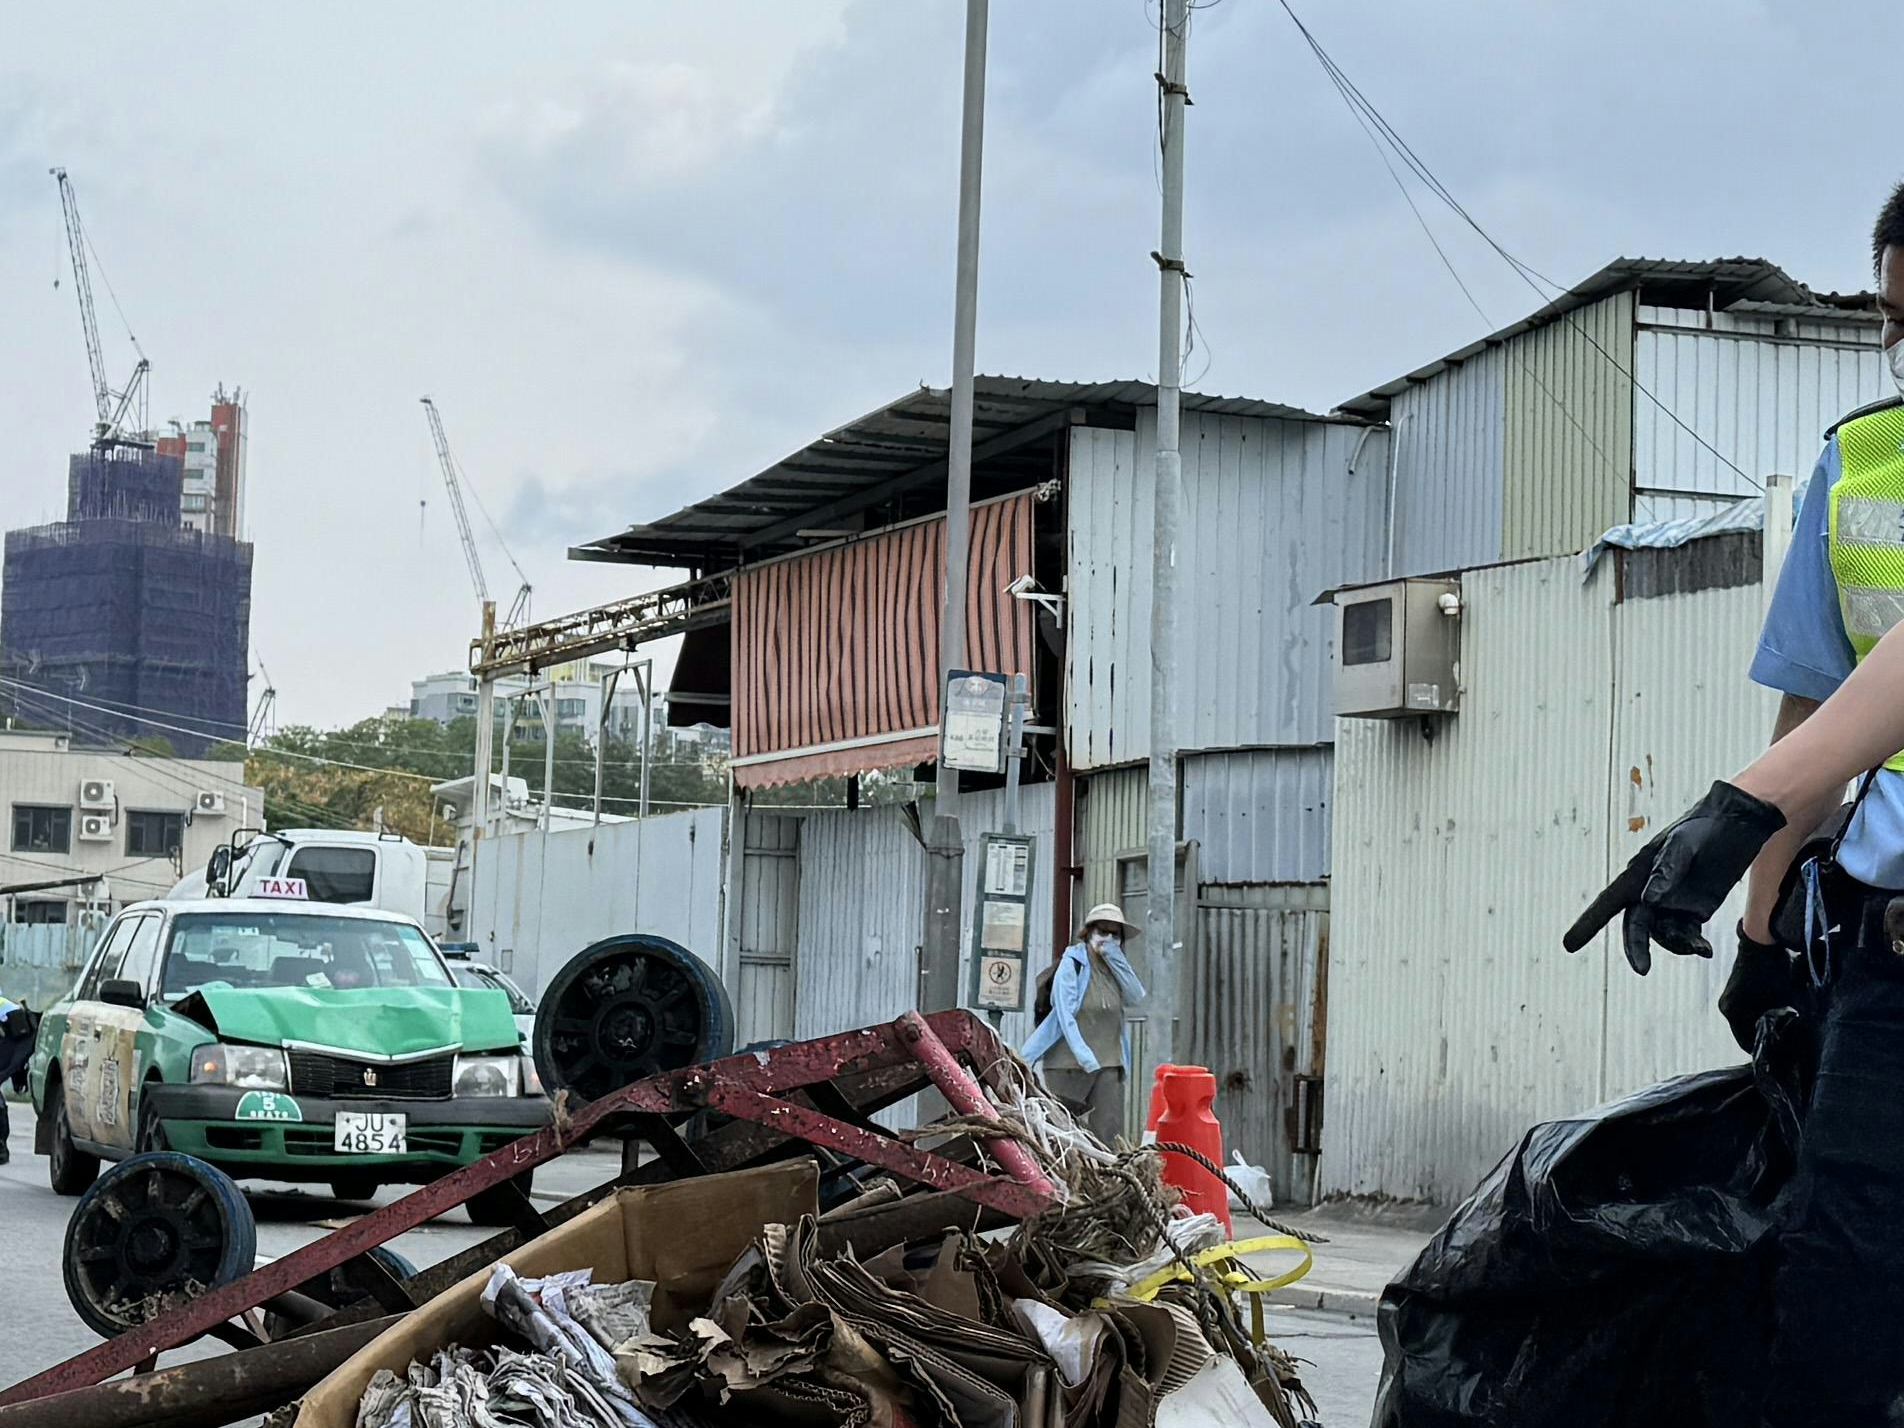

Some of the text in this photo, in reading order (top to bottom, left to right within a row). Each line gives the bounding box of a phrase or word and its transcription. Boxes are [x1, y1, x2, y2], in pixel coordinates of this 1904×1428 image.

[259, 879, 303, 896] TAXI
[263, 1097, 276, 1111] 5
[249, 1110, 289, 1119] SEATS
[355, 1113, 385, 1133] JU
[341, 1132, 402, 1152] 4854
